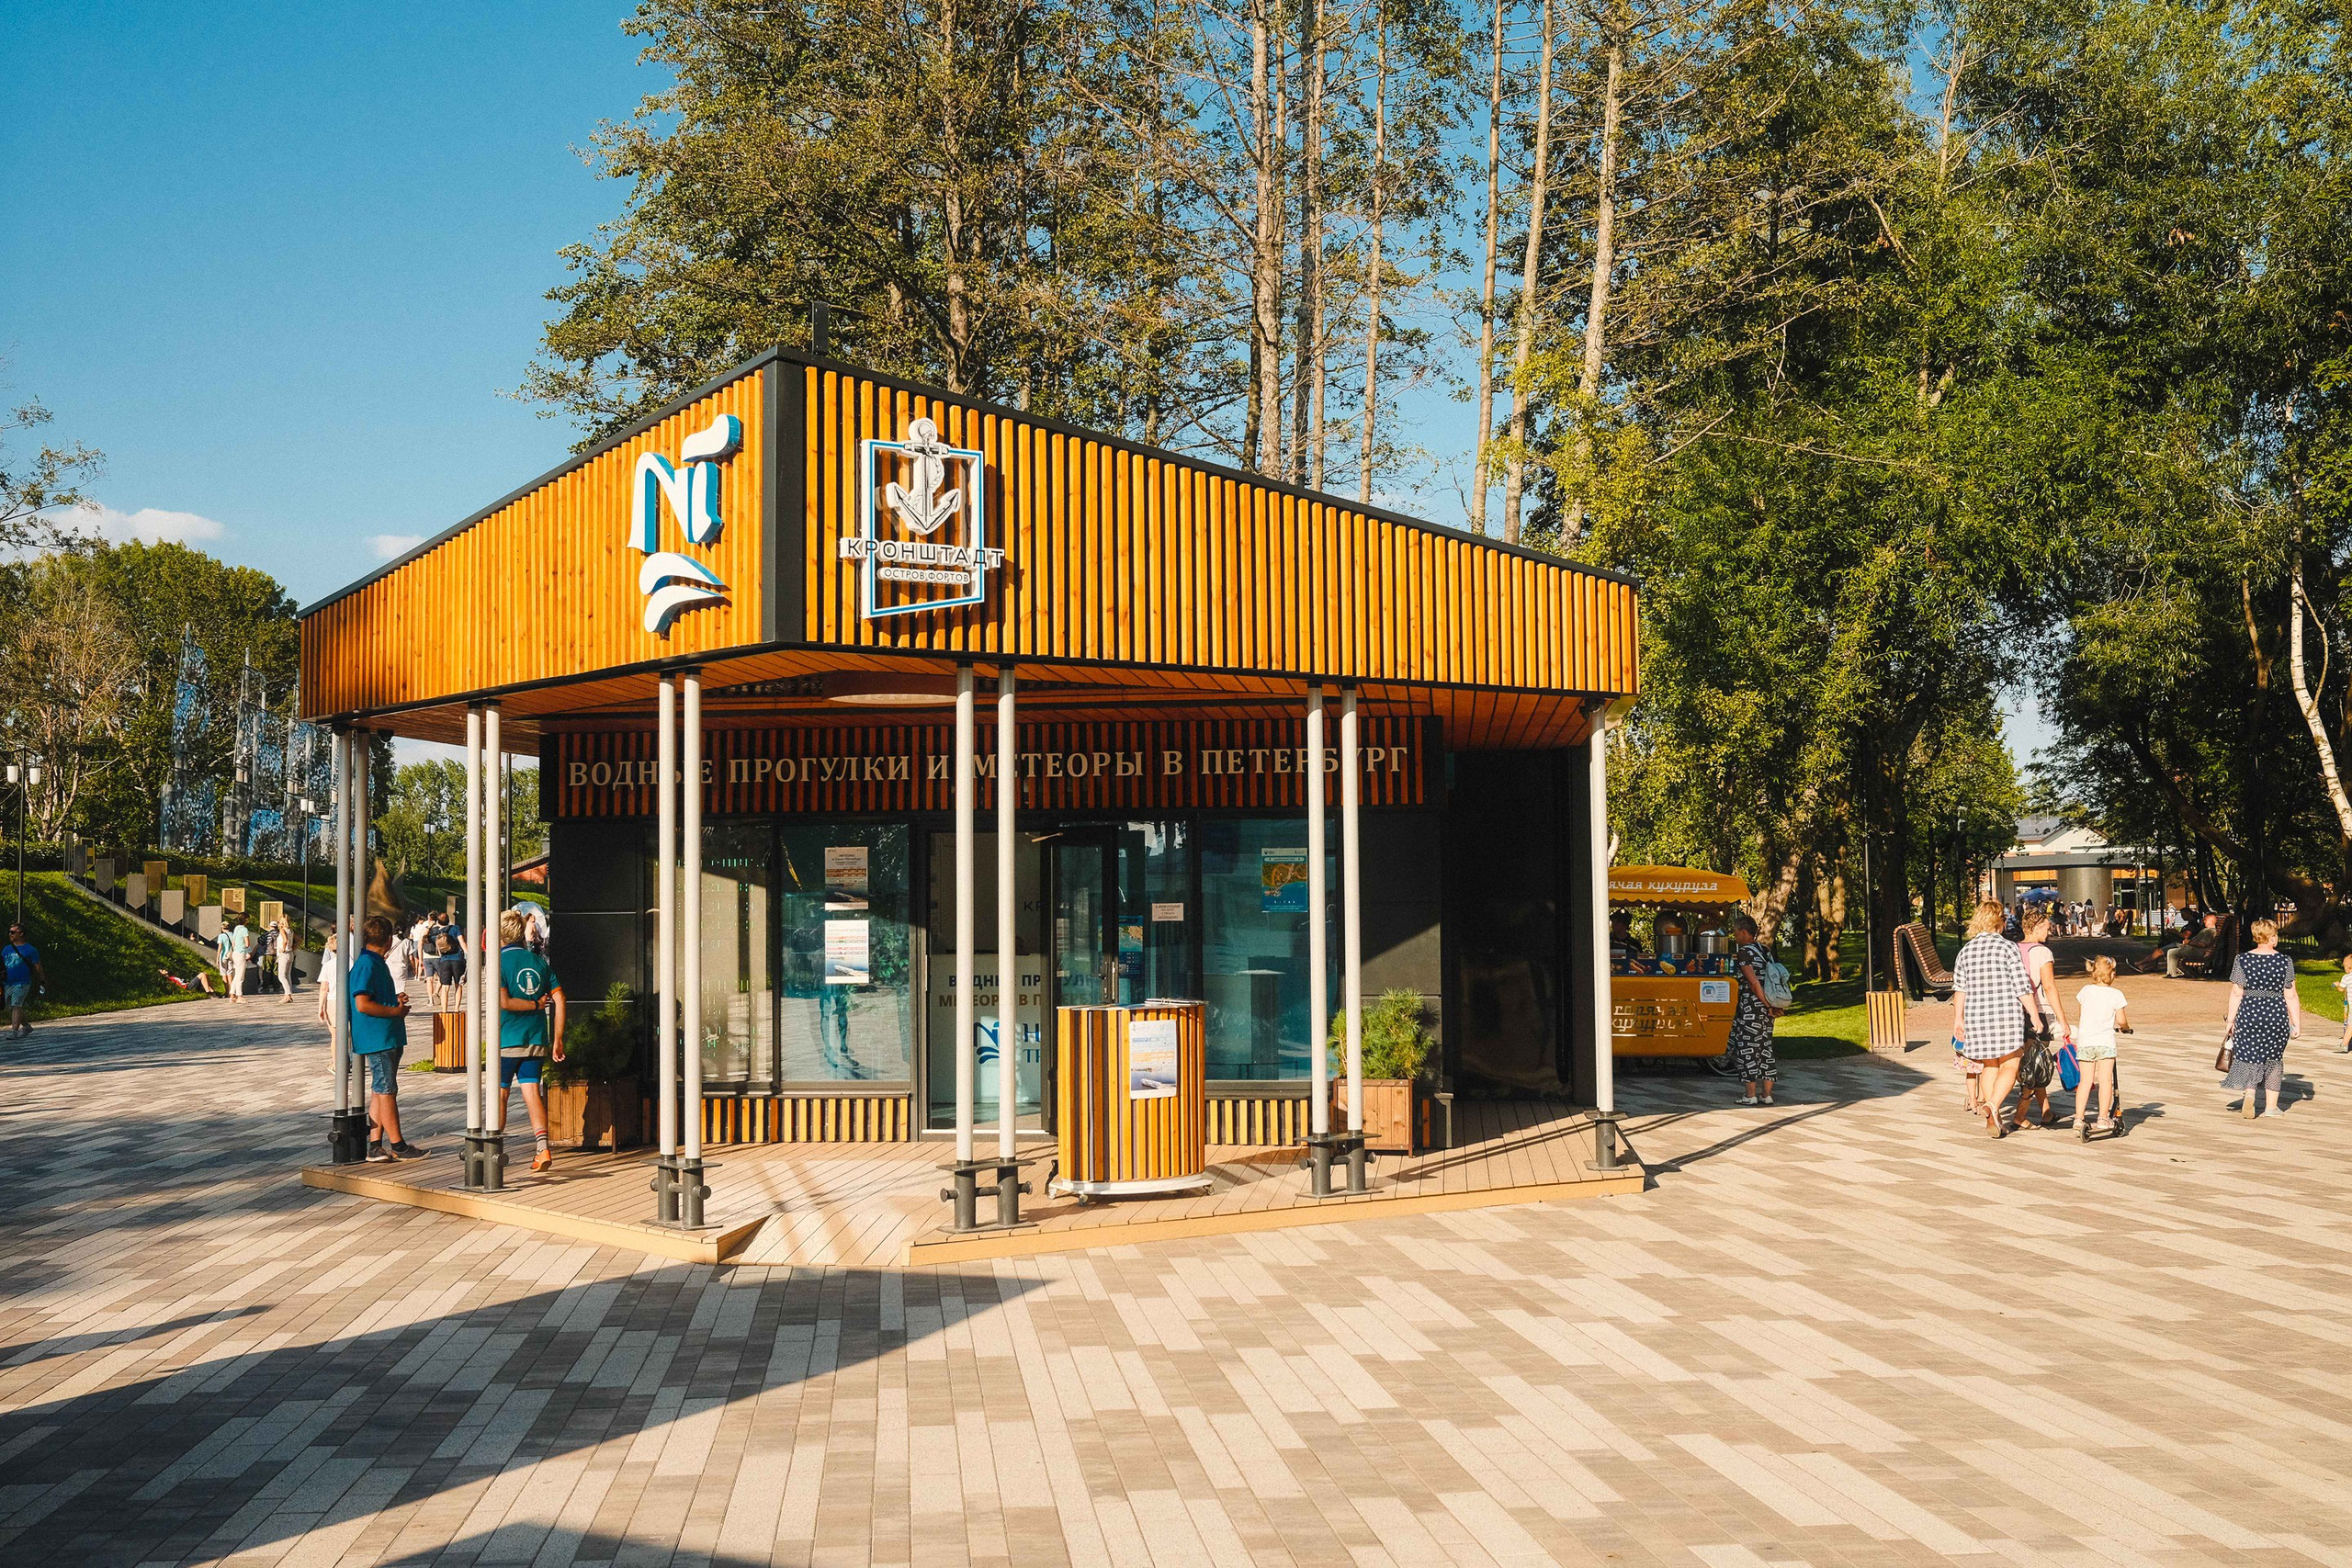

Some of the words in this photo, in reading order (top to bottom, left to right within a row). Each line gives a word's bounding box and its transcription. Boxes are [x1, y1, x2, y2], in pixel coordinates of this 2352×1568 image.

[845, 538, 1003, 569] КРОНШТАДТ
[884, 568, 925, 581] ОСТРОВ
[927, 570, 970, 583] ФОРТОВ
[729, 755, 910, 784] ПРОГУЛКИ
[926, 754, 949, 781] И
[972, 751, 1144, 779] МТЕОРЫ
[1162, 750, 1183, 775] В
[1201, 747, 1408, 774] ПЕТЕРБРГ
[1608, 880, 1643, 890] ячая
[1647, 881, 1718, 894] кукуруза
